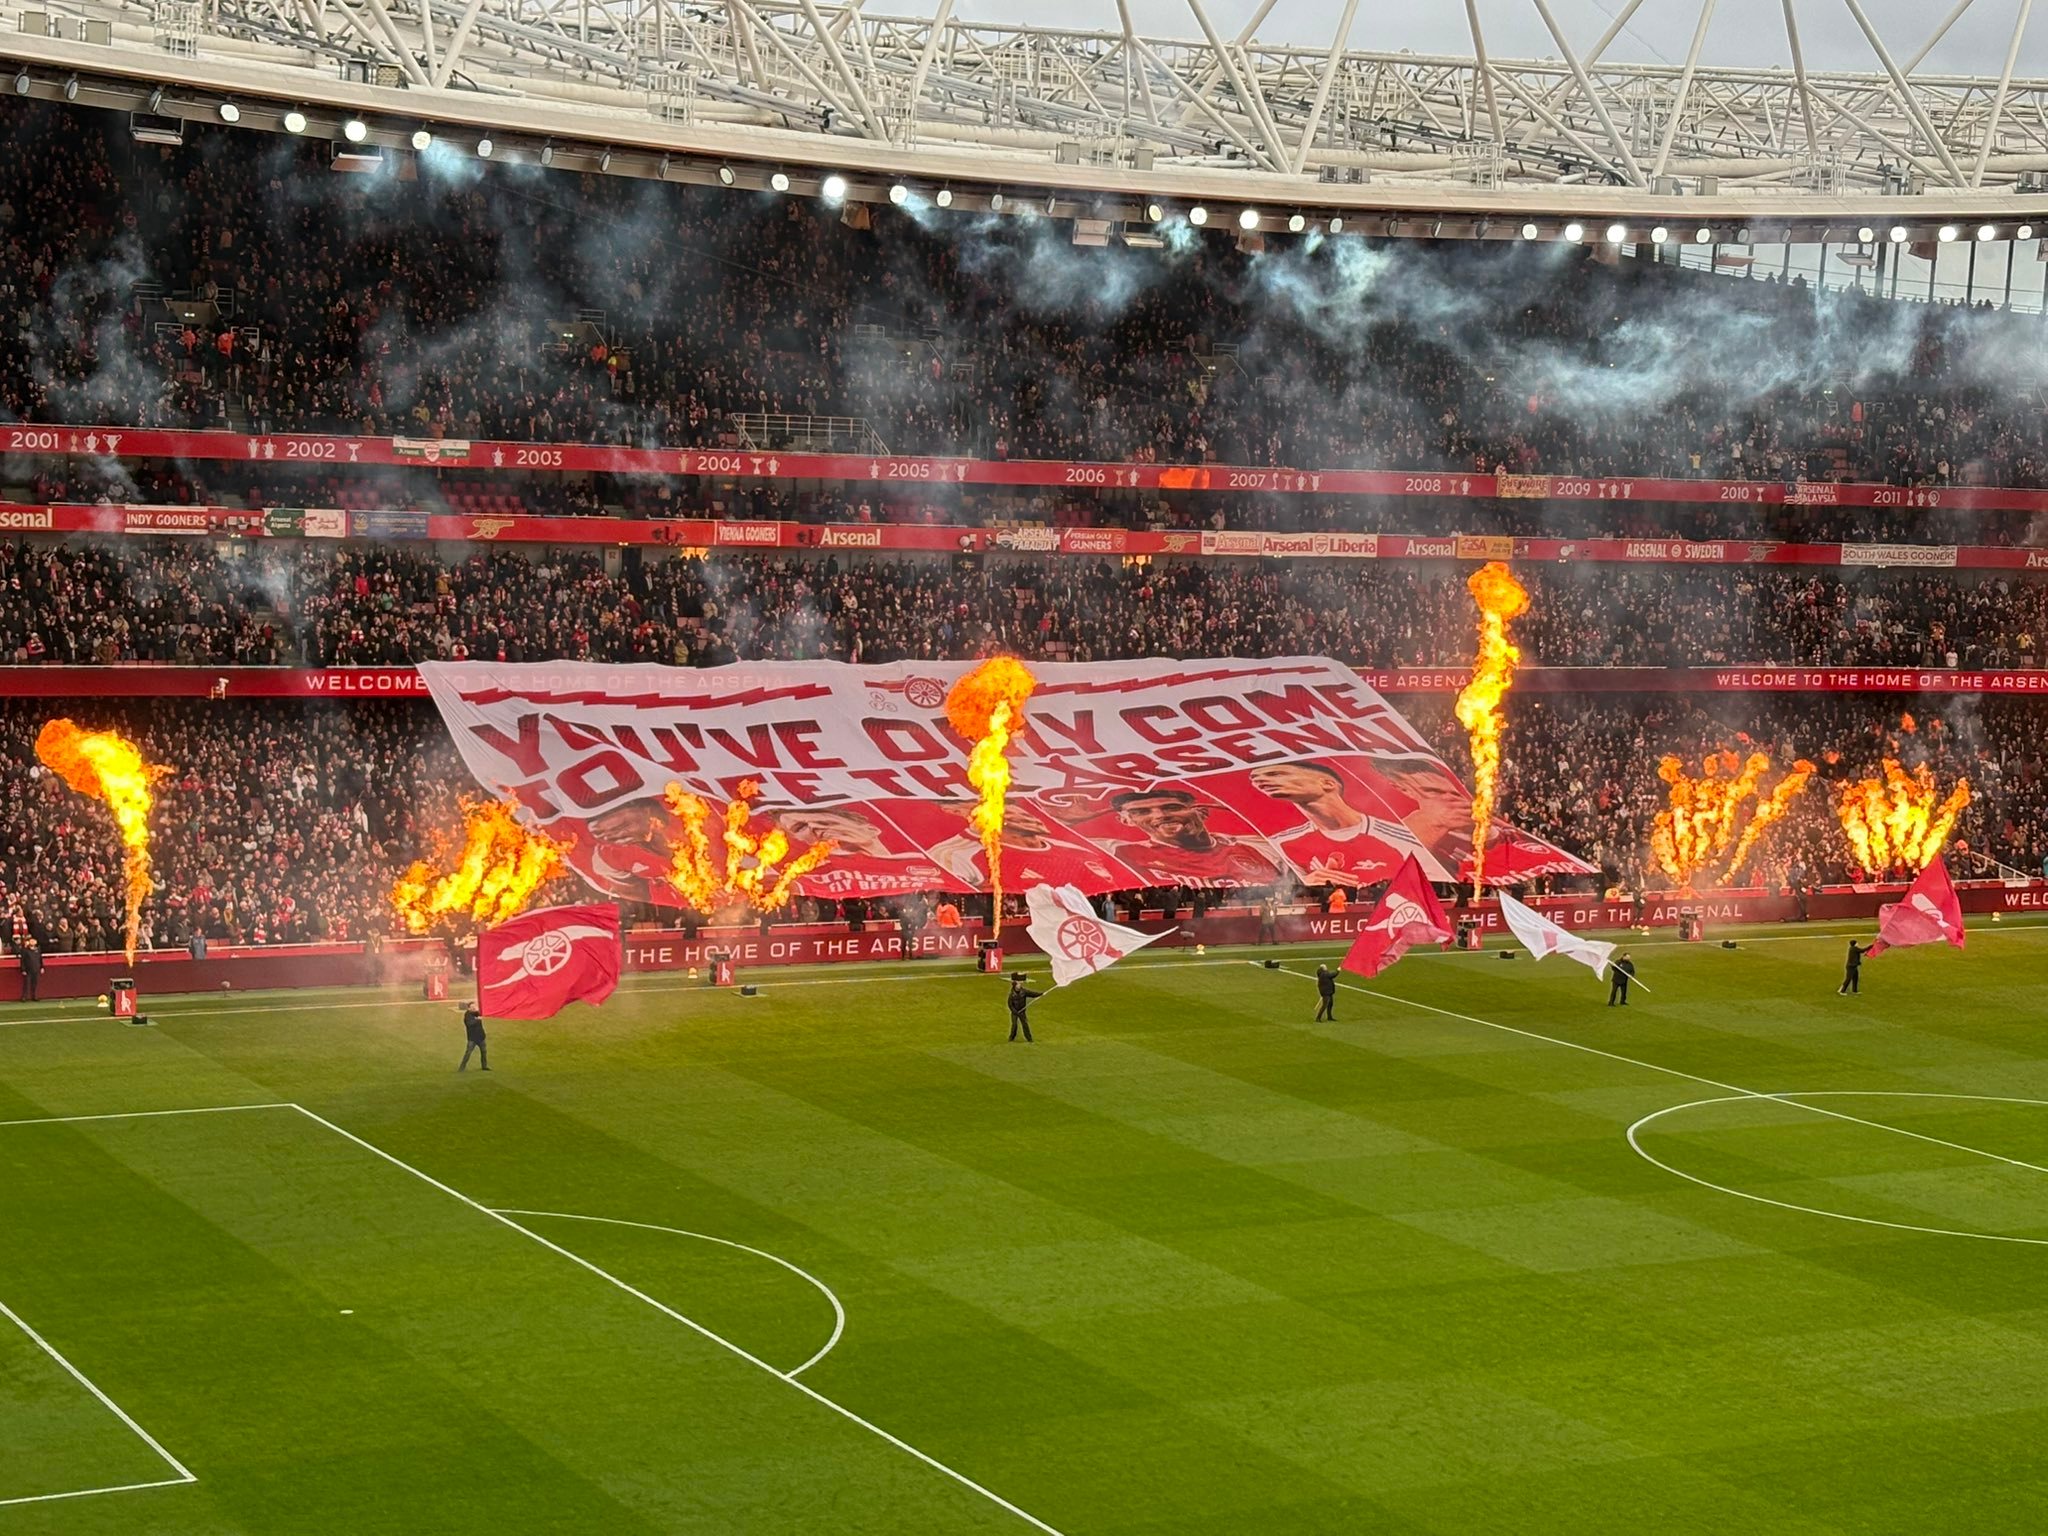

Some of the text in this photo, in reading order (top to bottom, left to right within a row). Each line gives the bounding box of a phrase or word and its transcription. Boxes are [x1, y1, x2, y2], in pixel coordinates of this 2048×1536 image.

[11, 432, 59, 449] 2001
[286, 441, 336, 458] 2002
[516, 450, 562, 466] 2003
[697, 456, 741, 472] 2004
[888, 463, 930, 478] 2005
[1065, 468, 1106, 483] 2006
[1229, 473, 1267, 488] 2007
[1405, 478, 1441, 492] 2008
[1556, 482, 1591, 496] 2009
[1721, 486, 1749, 499] 2010
[1873, 491, 1900, 504] 2011
[126, 514, 207, 527] INDY GOONERS
[719, 526, 776, 542] VIENNA GOONERS
[820, 528, 881, 546] Arsenal
[1017, 528, 1054, 538] ARSENAL
[1012, 540, 1058, 551] PARAGUAY
[1070, 541, 1112, 550] GUNNERS
[1263, 537, 1376, 552] Arsenal Liberia
[1405, 540, 1456, 556] Arsenal
[1626, 543, 1724, 559] ARSENAL SWEDEN
[1843, 550, 1956, 561] SOUTH WALES GOONERS
[306, 675, 427, 690] WELCOME
[534, 675, 596, 689] HOME
[608, 675, 636, 689] OF
[648, 675, 687, 689] THE
[1361, 675, 1471, 687] HE ARSENA
[1717, 674, 1796, 686] WELCOME
[1803, 674, 1823, 686] TO
[1829, 674, 1858, 686] THE
[1864, 674, 1911, 687] HOME
[1919, 675, 1942, 687] OF
[1950, 676, 1983, 688] THE
[1119, 683, 1388, 744] COME
[498, 750, 645, 819] TO
[847, 761, 1042, 797] TH
[1034, 716, 1440, 806] ARSENAL
[803, 869, 945, 885] Emirates
[828, 880, 925, 893] FLY BETTER
[1574, 909, 1598, 923] OF
[626, 935, 980, 964] THE HOME OF THE ARSENAL
